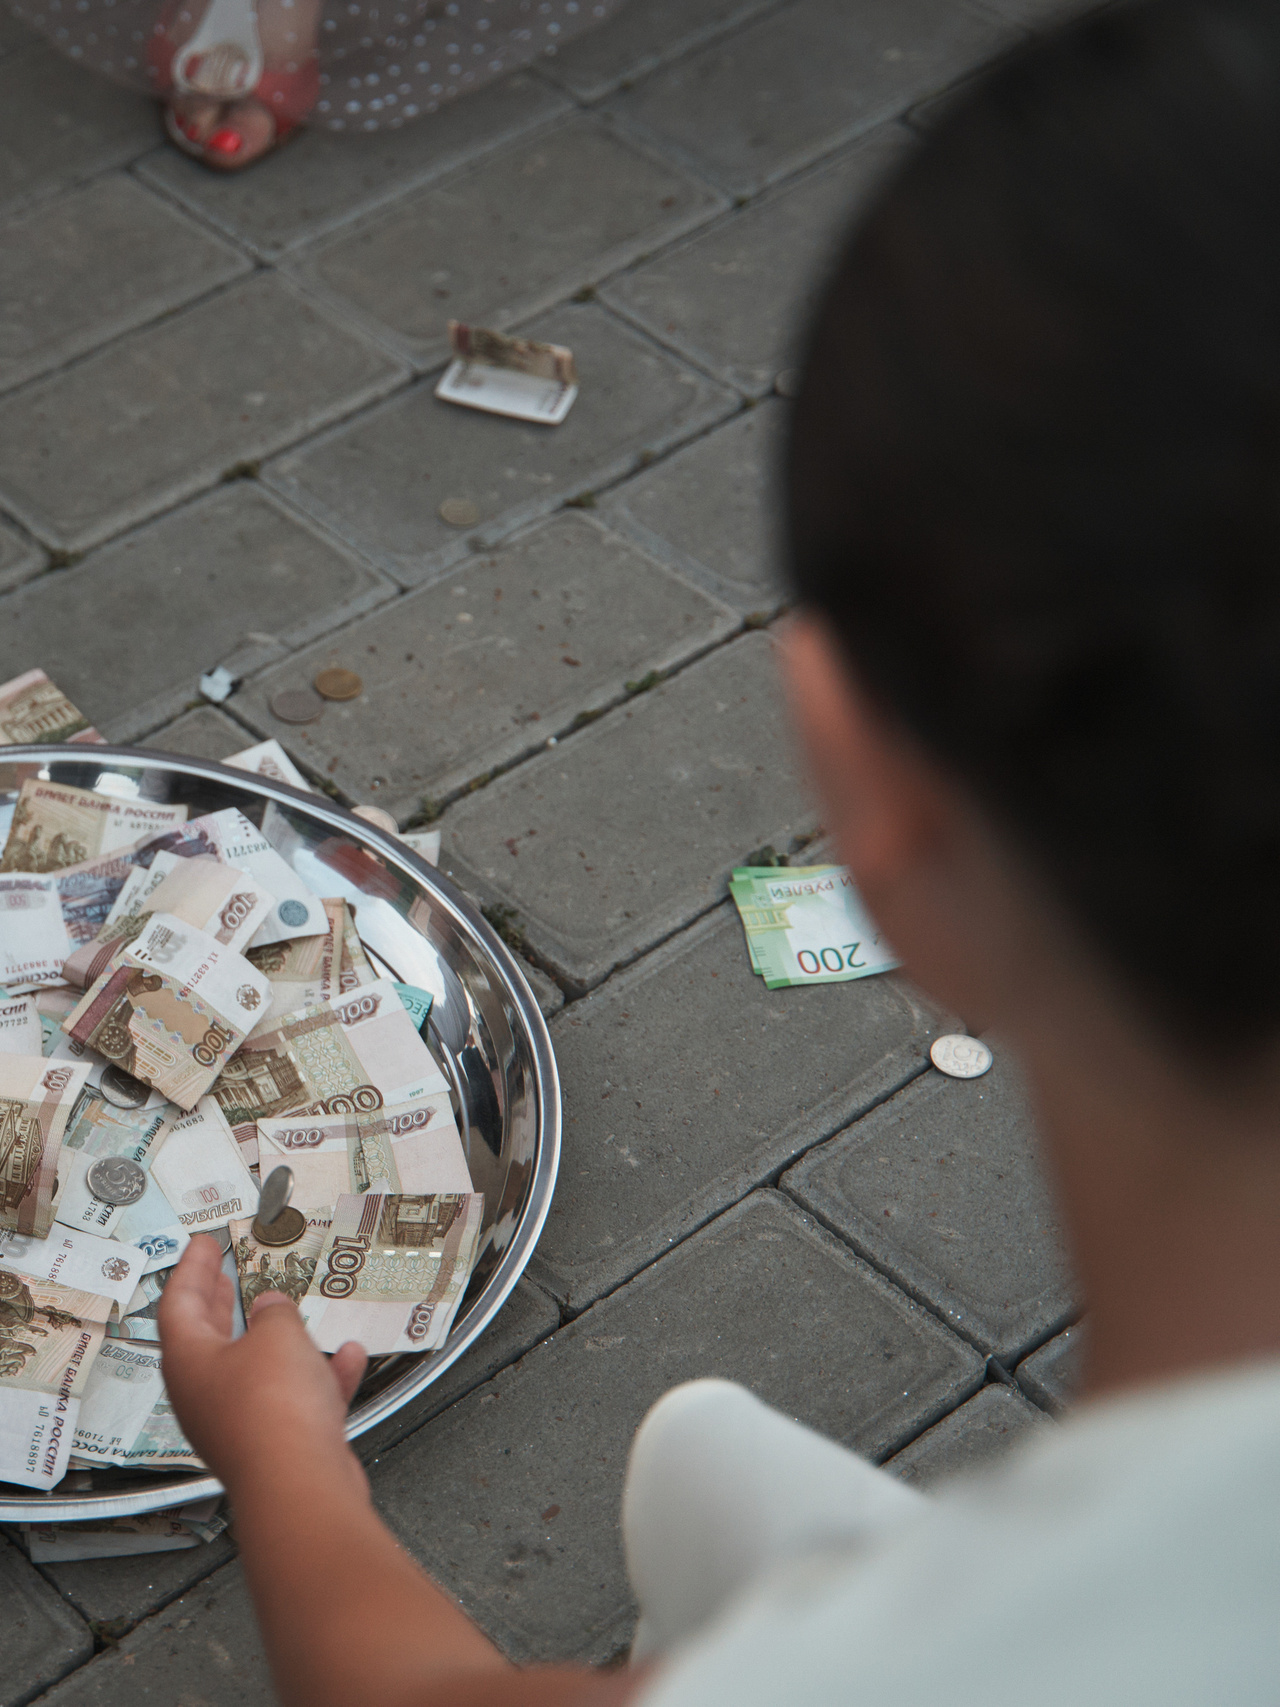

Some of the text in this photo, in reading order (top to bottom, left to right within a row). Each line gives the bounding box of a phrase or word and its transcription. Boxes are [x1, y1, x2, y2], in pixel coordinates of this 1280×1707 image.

[79, 795, 121, 814] БАНКА
[124, 804, 176, 822] РОССИИ
[770, 879, 835, 898] РУБЛЕЙ
[222, 894, 257, 930] 100
[796, 941, 866, 975] 200
[322, 955, 332, 990] БАНКА
[339, 996, 374, 1023] 100
[191, 1019, 236, 1068] 100
[44, 1067, 72, 1092] 100
[408, 1087, 425, 1098] 1997
[313, 1084, 384, 1116] 100
[145, 1116, 165, 1147] БИЛЕТ
[388, 1109, 427, 1134] 100
[282, 1128, 322, 1148] 100
[105, 1162, 128, 1185] 5
[199, 1185, 220, 1205] 100
[176, 1196, 243, 1226] РУБЛЕЙ
[142, 1237, 169, 1259] 50
[320, 1232, 371, 1299] 100
[408, 1302, 435, 1337] 100
[115, 1364, 134, 1379] 50
[41, 1332, 92, 1478] БИЛЕТ БАНКА РОССИИ
[25, 1423, 46, 1474] 7618897
[70, 1438, 109, 1456] РОСС
